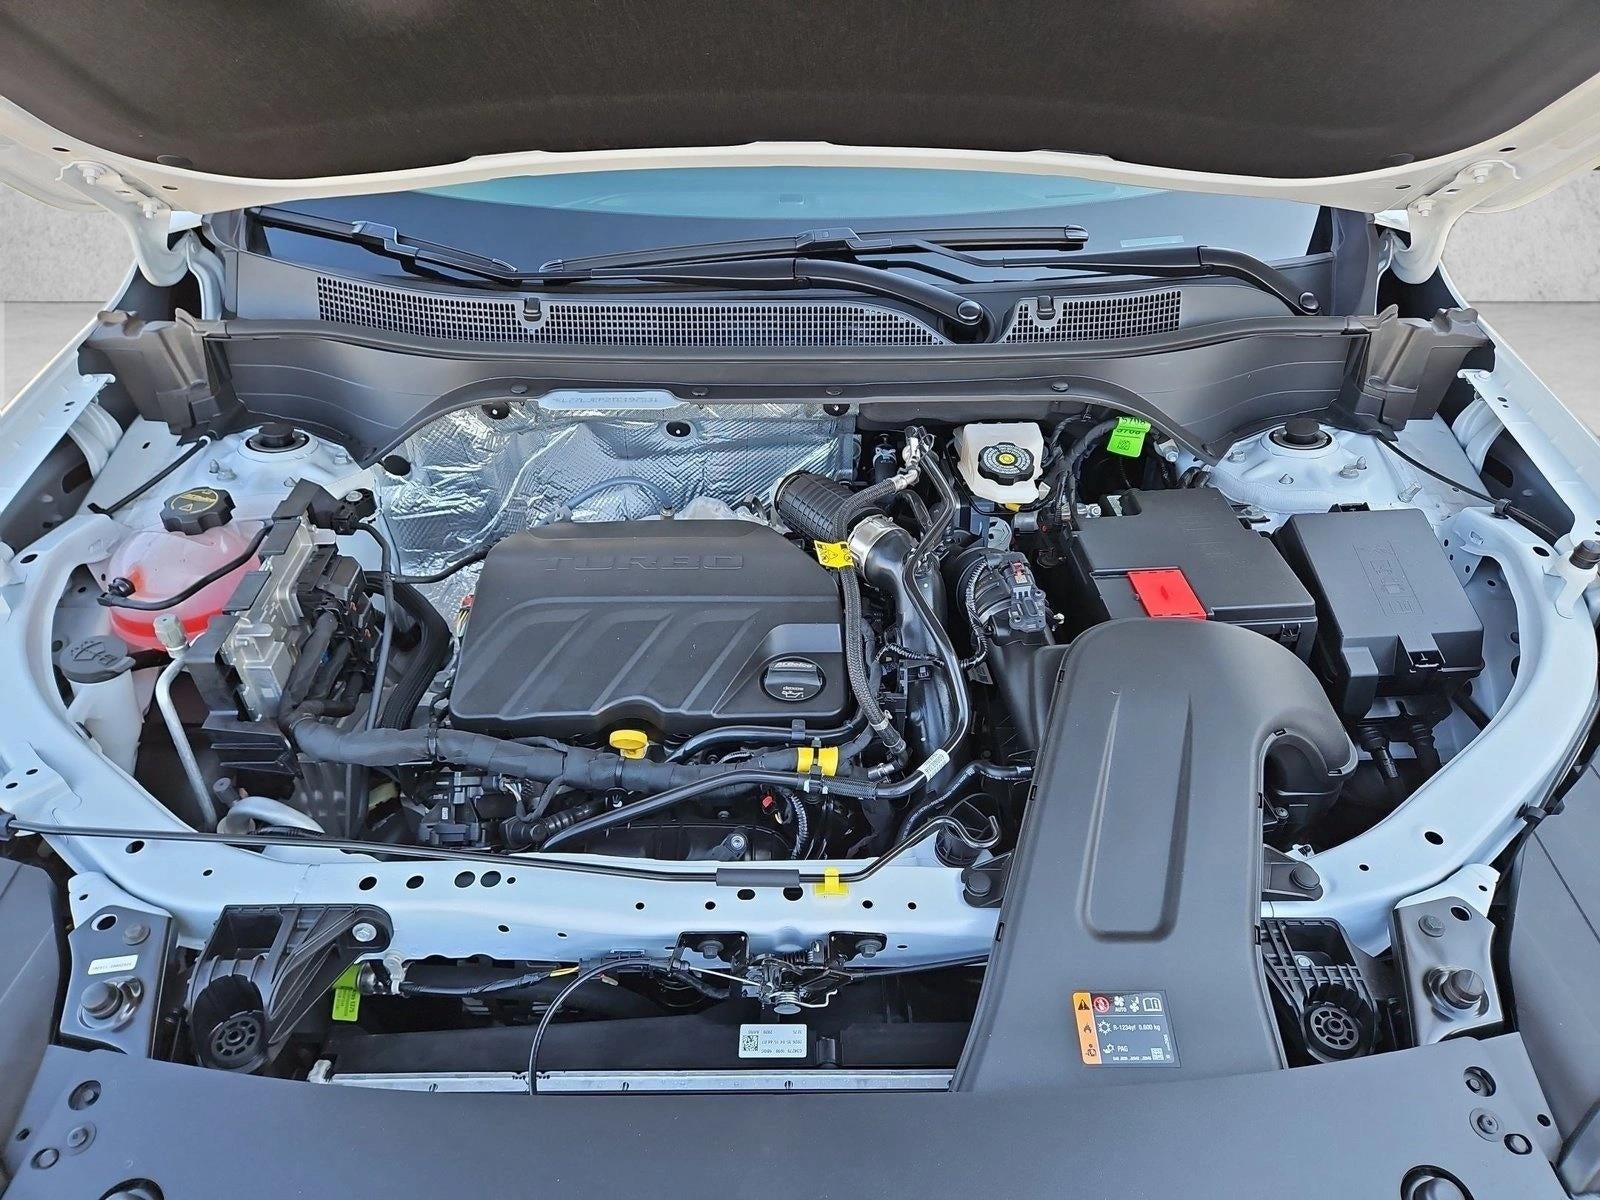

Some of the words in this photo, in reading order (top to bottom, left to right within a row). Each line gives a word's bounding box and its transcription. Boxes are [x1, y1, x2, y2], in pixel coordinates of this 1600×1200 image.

[536, 554, 744, 571] TURBO
[1153, 1024, 1161, 1033] kg
[1117, 1045, 1129, 1053] PAG
